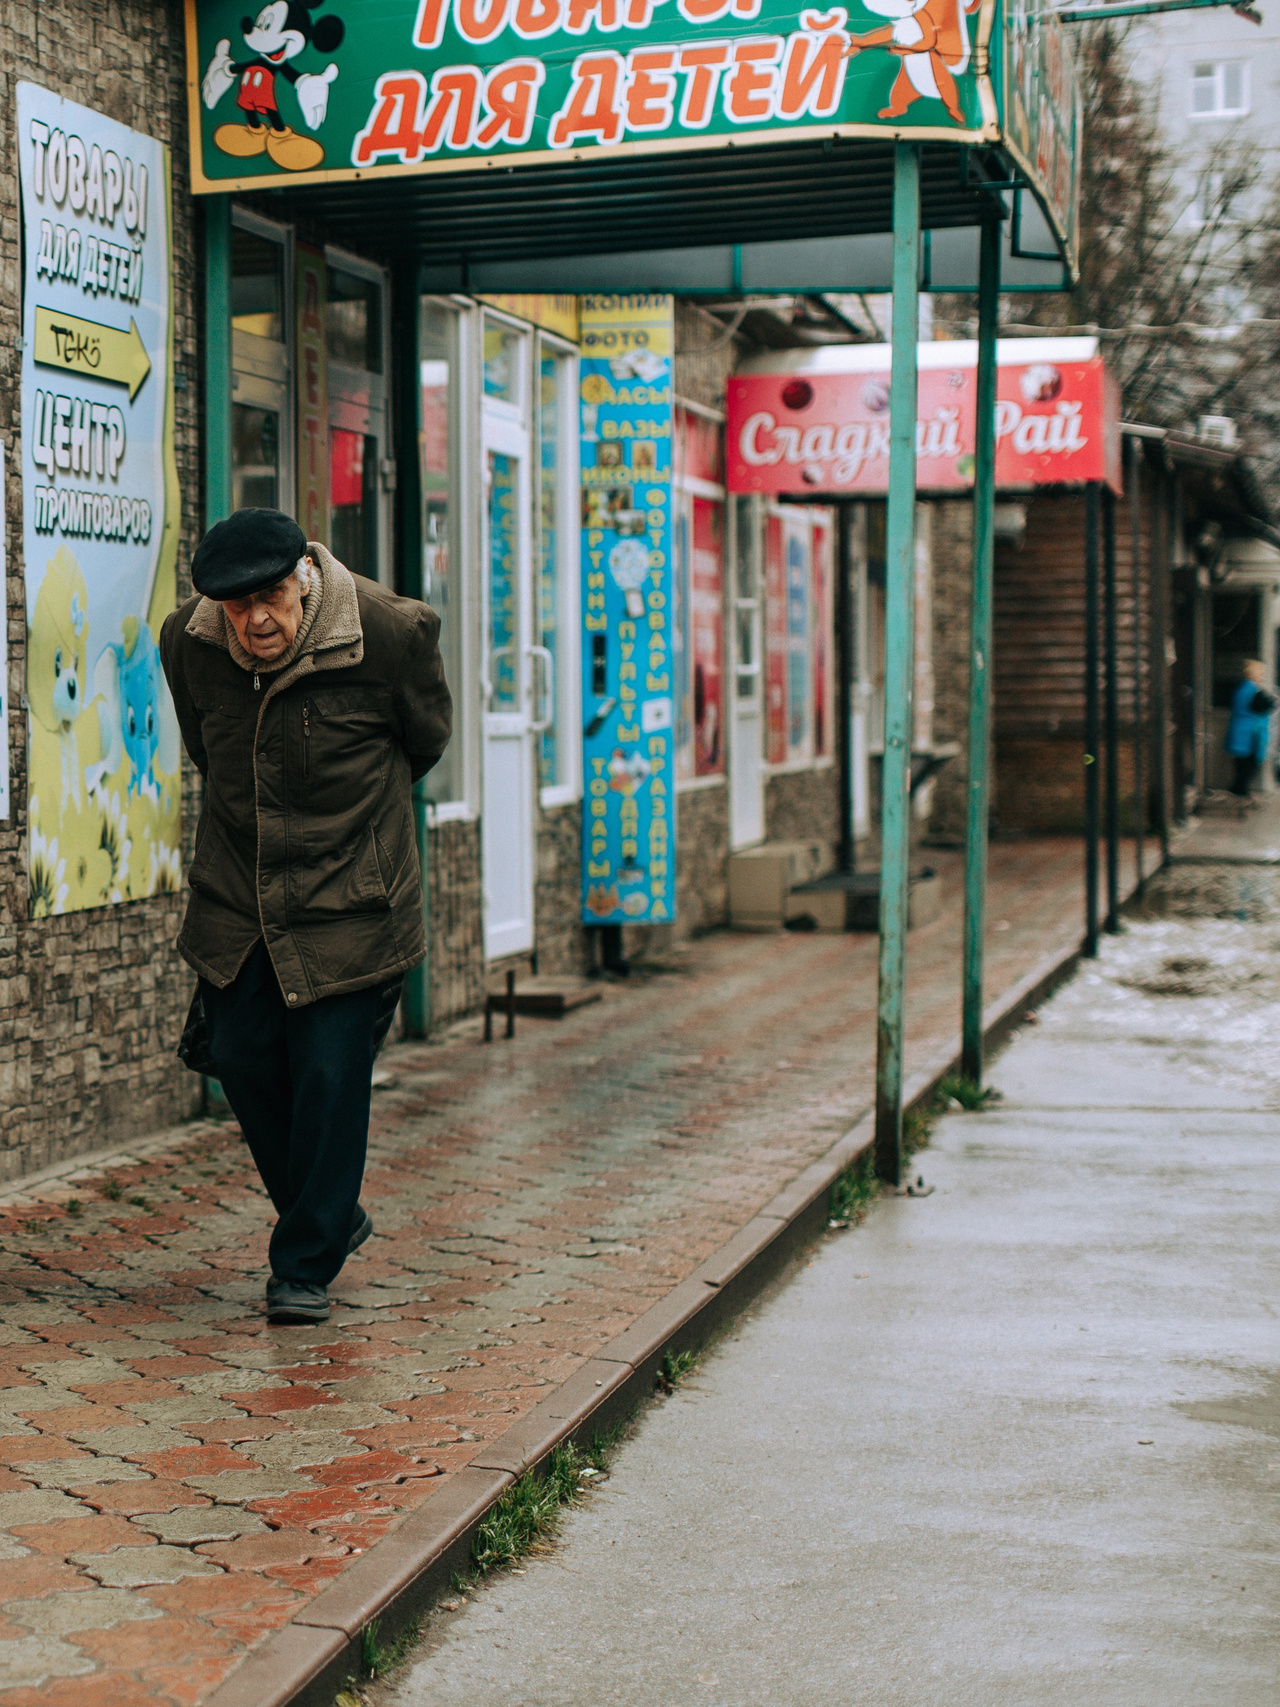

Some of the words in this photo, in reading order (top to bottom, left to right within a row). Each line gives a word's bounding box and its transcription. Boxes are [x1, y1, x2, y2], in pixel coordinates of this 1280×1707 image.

[352, 58, 545, 167] ДЛЯ
[548, 8, 848, 148] ДЕТЕЙ
[31, 118, 148, 239] ТОВАРЫ
[37, 219, 81, 283] ДЛЯ
[83, 235, 143, 304] ДЕТЕЙ
[584, 331, 649, 348] ФОТО
[32, 388, 126, 479] ЦЕНТР
[602, 420, 669, 438] ВАЗЫ
[995, 400, 1089, 455] Рай
[35, 485, 151, 540] ПРОМТОВАРОВ
[582, 465, 669, 483] ИКОНЫ
[645, 489, 669, 691] ФОТОТОВАРЫ
[618, 621, 640, 743] ПУЛЬТЫ
[588, 758, 610, 878] ТОВАРЫ
[649, 736, 668, 917] ПРАЗДНИКА
